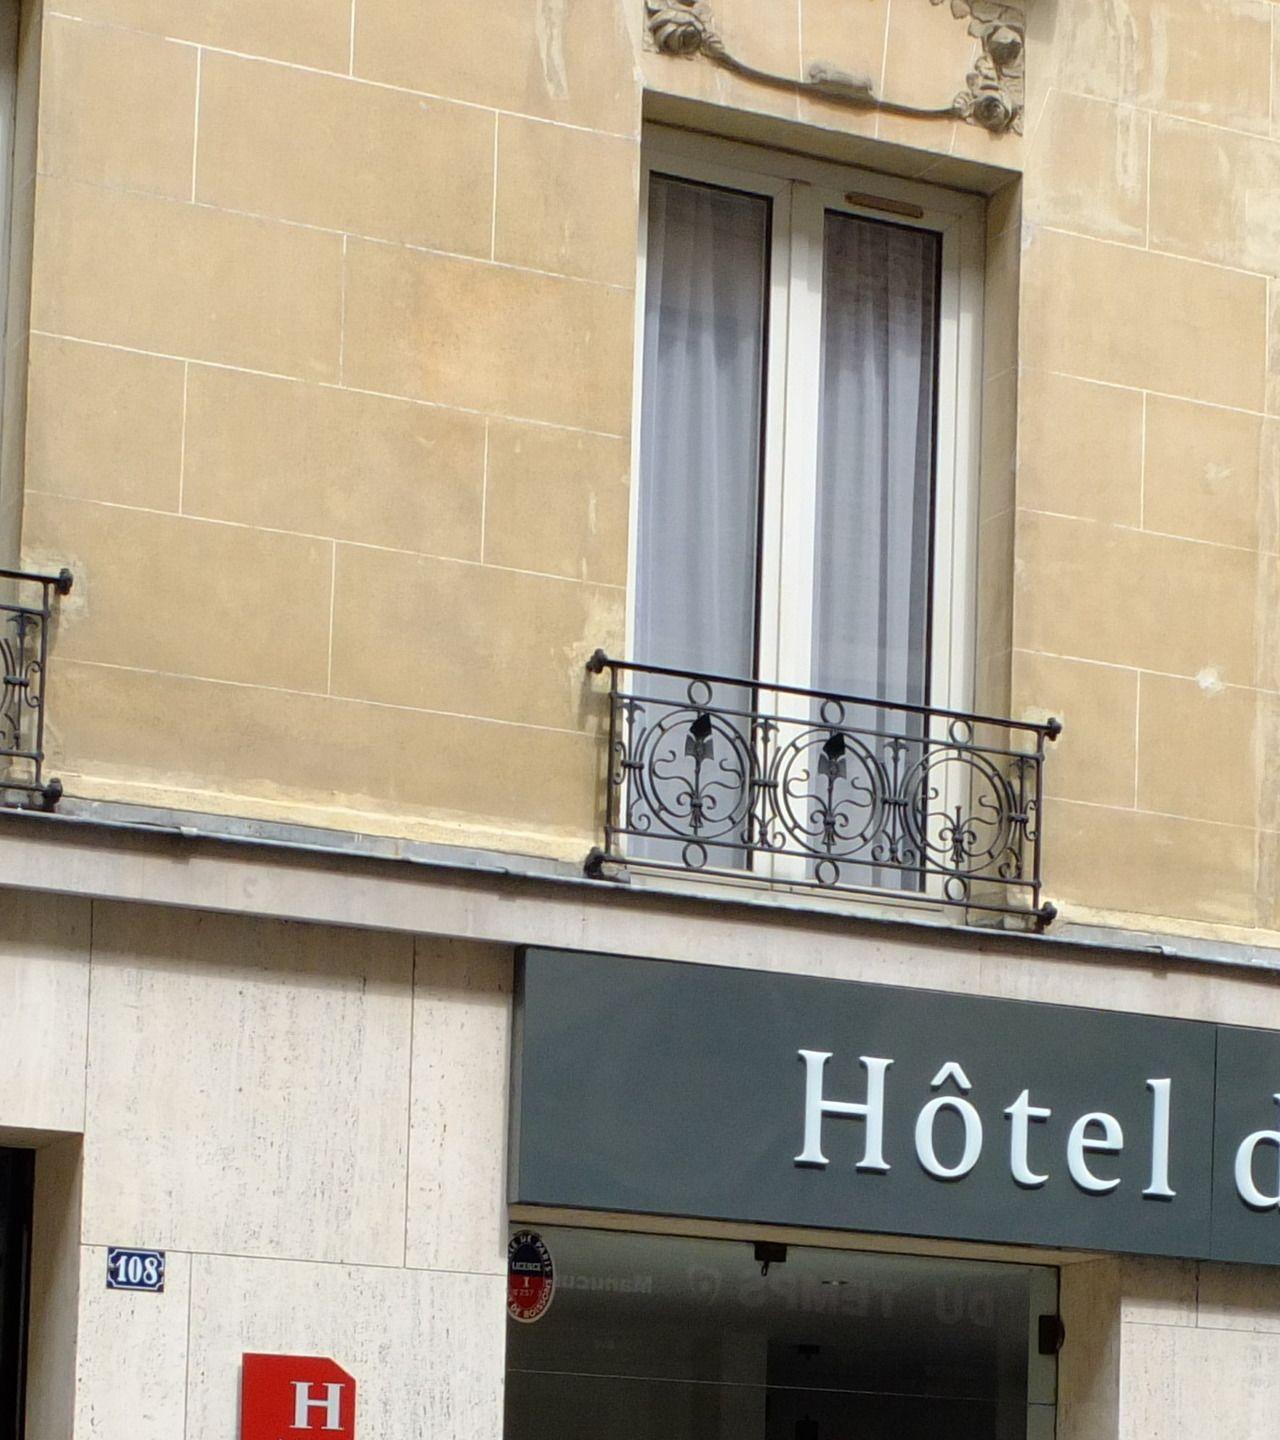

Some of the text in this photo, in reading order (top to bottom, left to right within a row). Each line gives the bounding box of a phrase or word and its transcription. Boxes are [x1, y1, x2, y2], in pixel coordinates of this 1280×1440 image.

[792, 1048, 1179, 1199] Hôtel
[115, 1254, 158, 1285] 108
[512, 1261, 541, 1271] LICENCE
[535, 1241, 553, 1273] PARIS
[523, 1278, 553, 1319] BOISSONS
[289, 1380, 345, 1431] H
